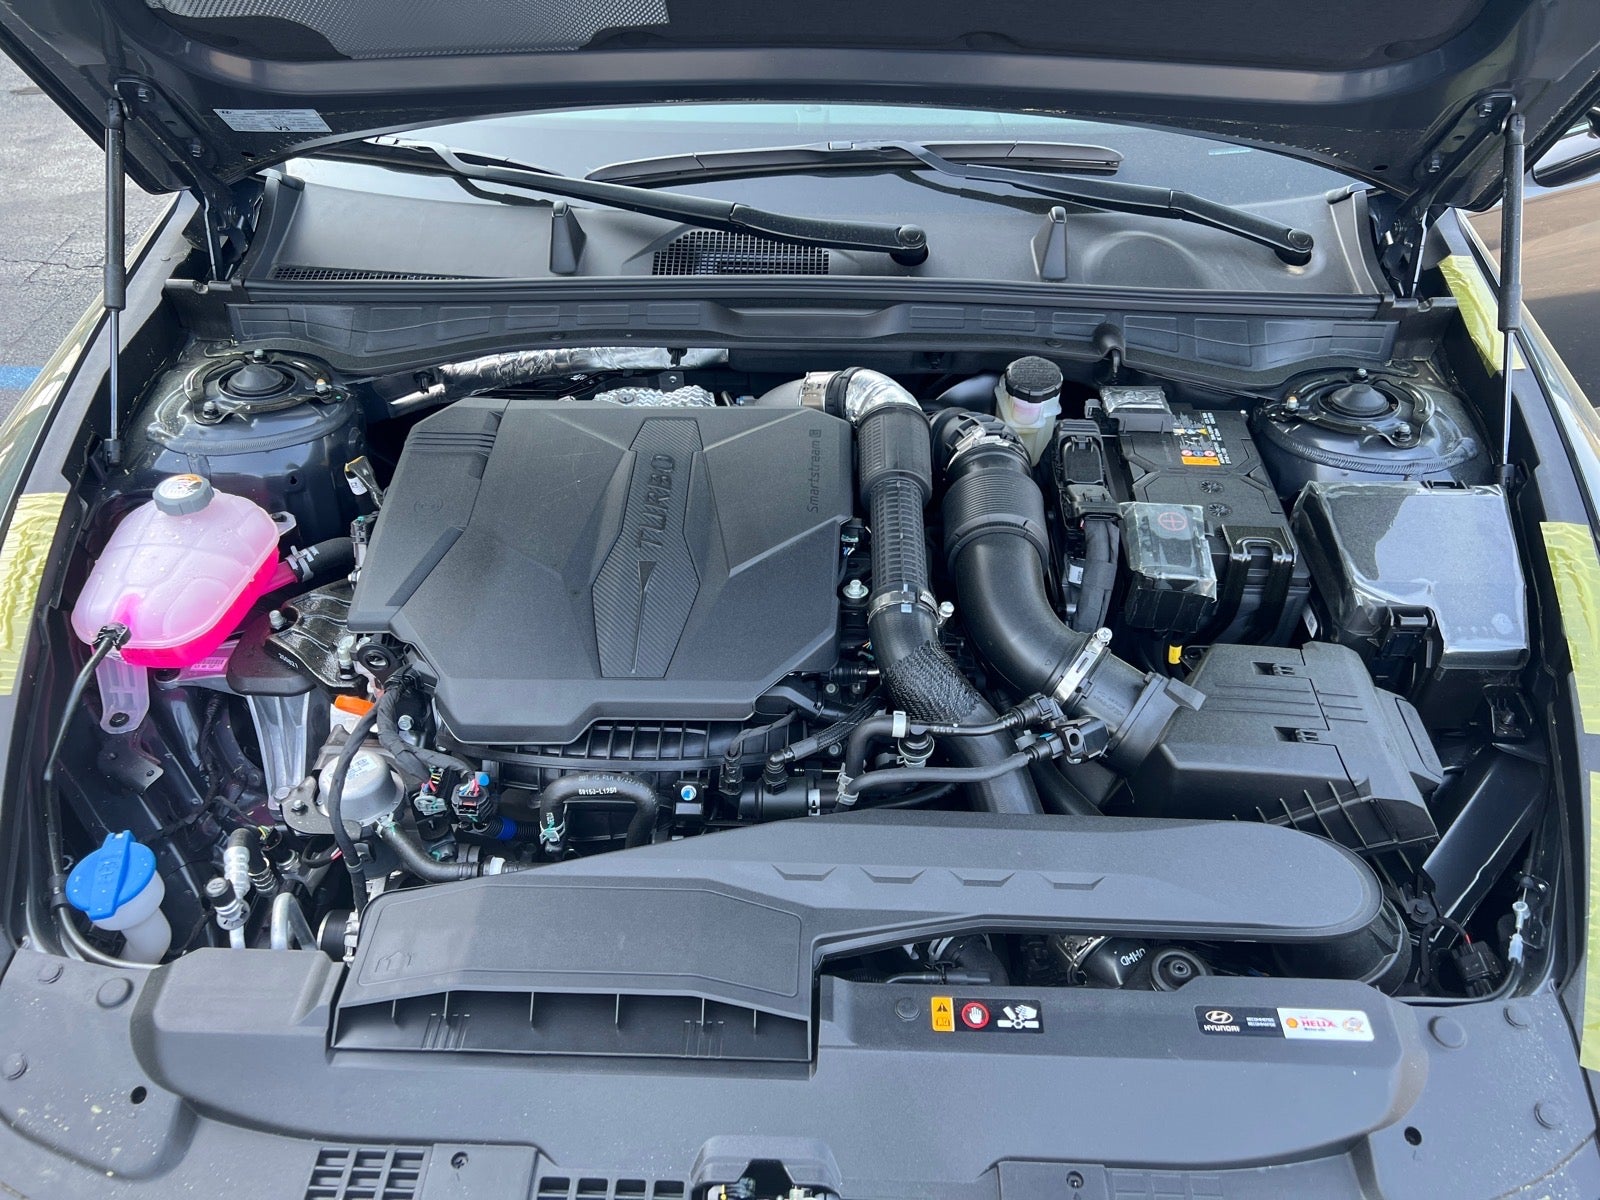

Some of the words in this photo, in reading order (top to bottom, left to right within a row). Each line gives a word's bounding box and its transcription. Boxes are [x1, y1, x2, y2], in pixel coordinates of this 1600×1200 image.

[635, 453, 675, 549] TURBO
[807, 440, 821, 514] Smartstream
[1203, 1024, 1240, 1033] HYUNDAI
